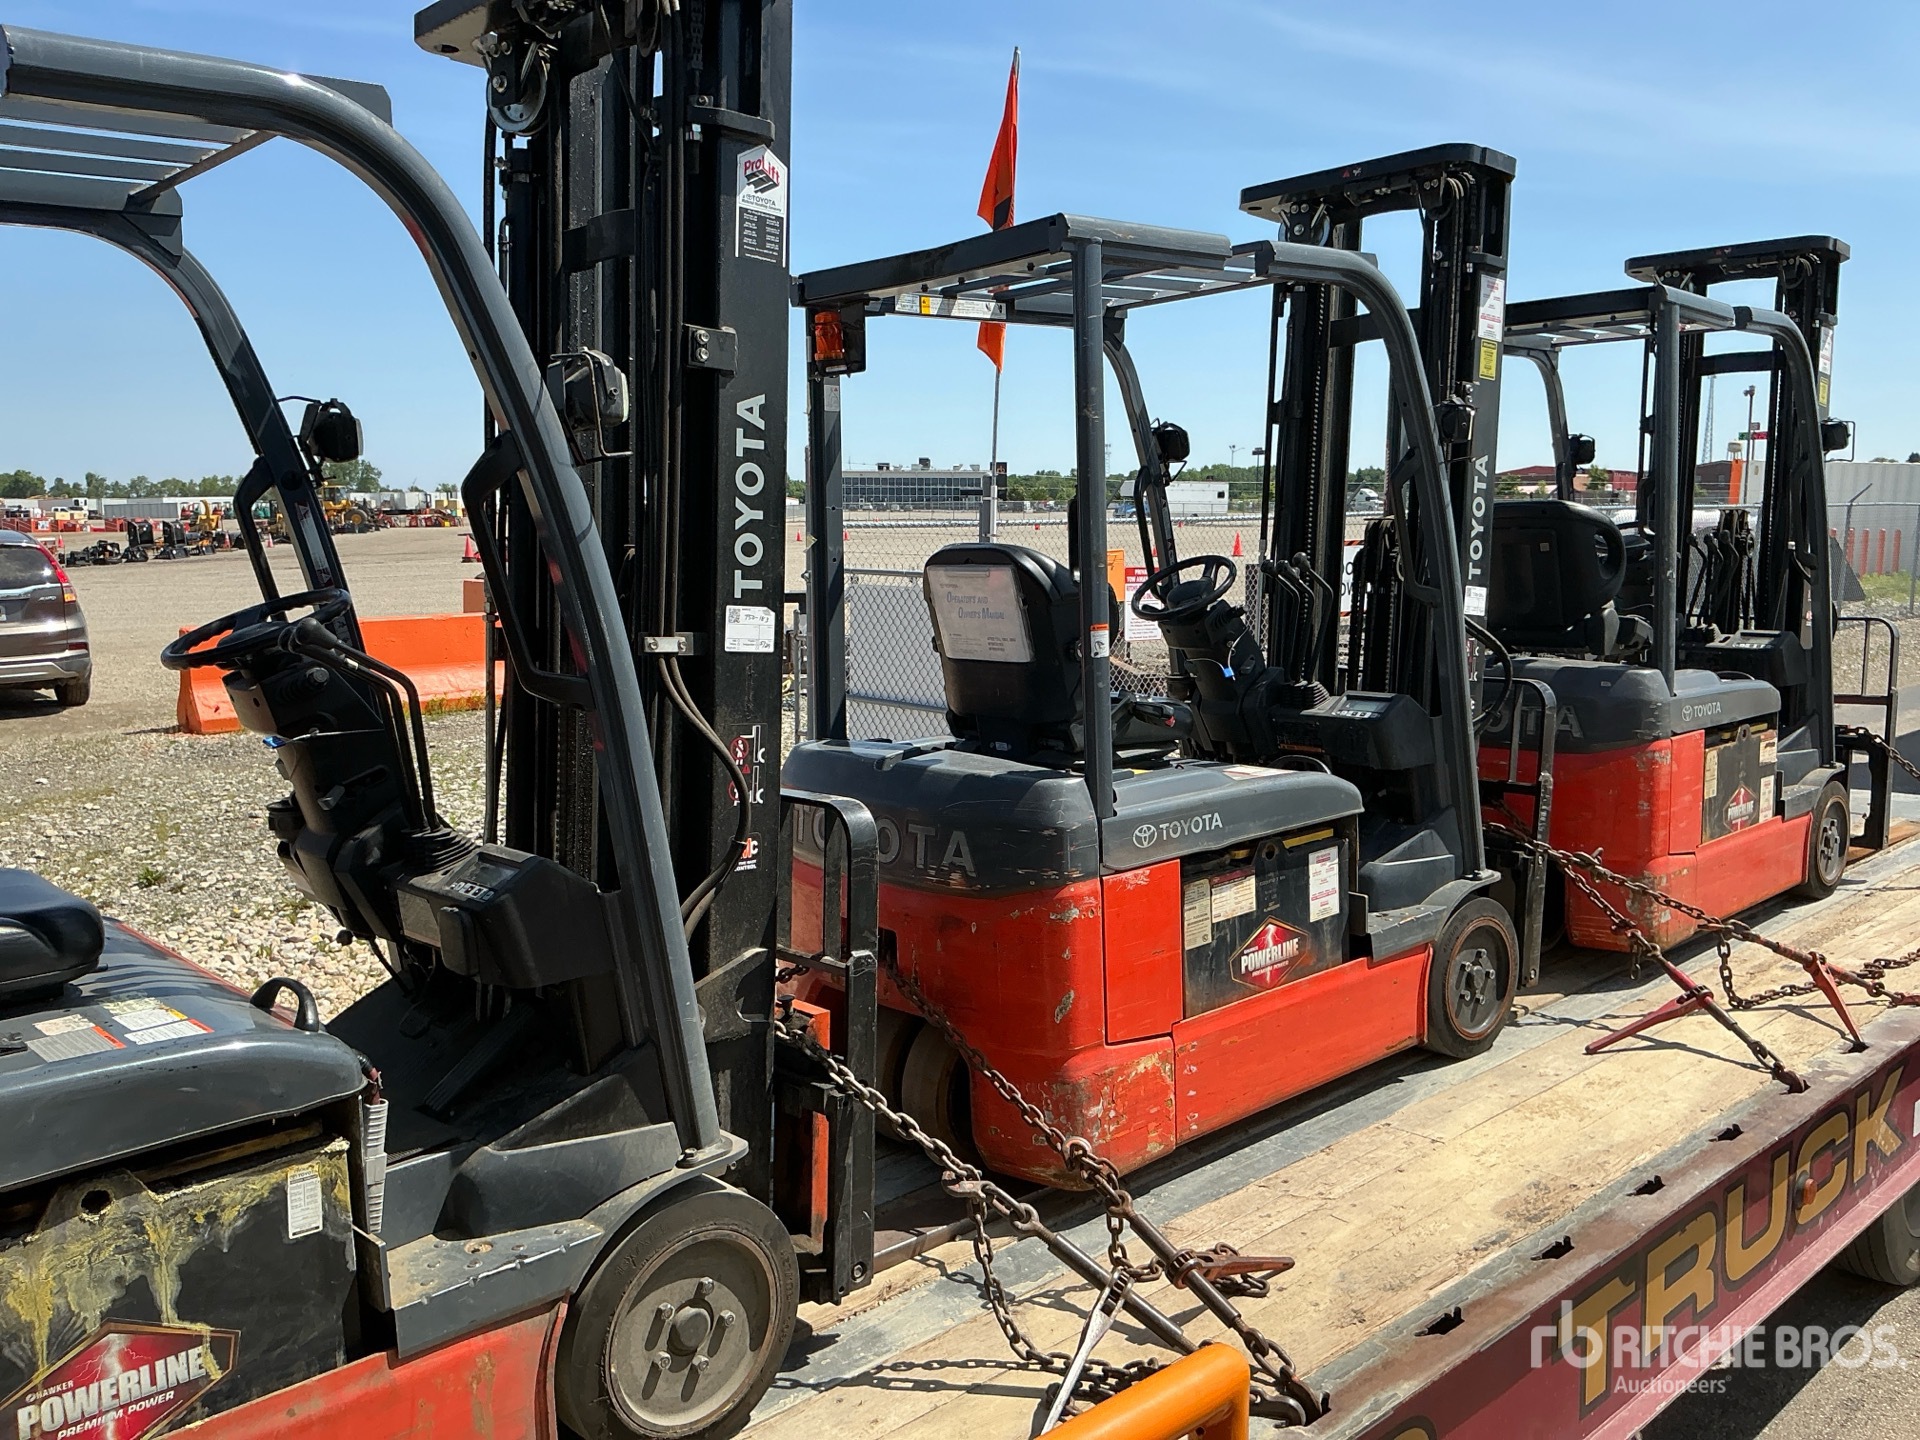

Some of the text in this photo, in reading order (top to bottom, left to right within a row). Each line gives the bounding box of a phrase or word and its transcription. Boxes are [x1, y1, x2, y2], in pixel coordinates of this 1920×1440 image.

[752, 195, 776, 206] TOYOTA
[734, 393, 766, 599] TOYOTA
[1468, 454, 1489, 581] TOYOTA
[1693, 701, 1722, 718] TOYOTA
[1159, 812, 1223, 841] TOYOTA
[1241, 938, 1299, 975] POWERLINE
[1556, 1064, 1905, 1407] TRUCK
[17, 1344, 206, 1440] POWERLINE
[35, 1380, 74, 1400] HAWKER
[57, 1390, 175, 1440] PREMIUM POWER
